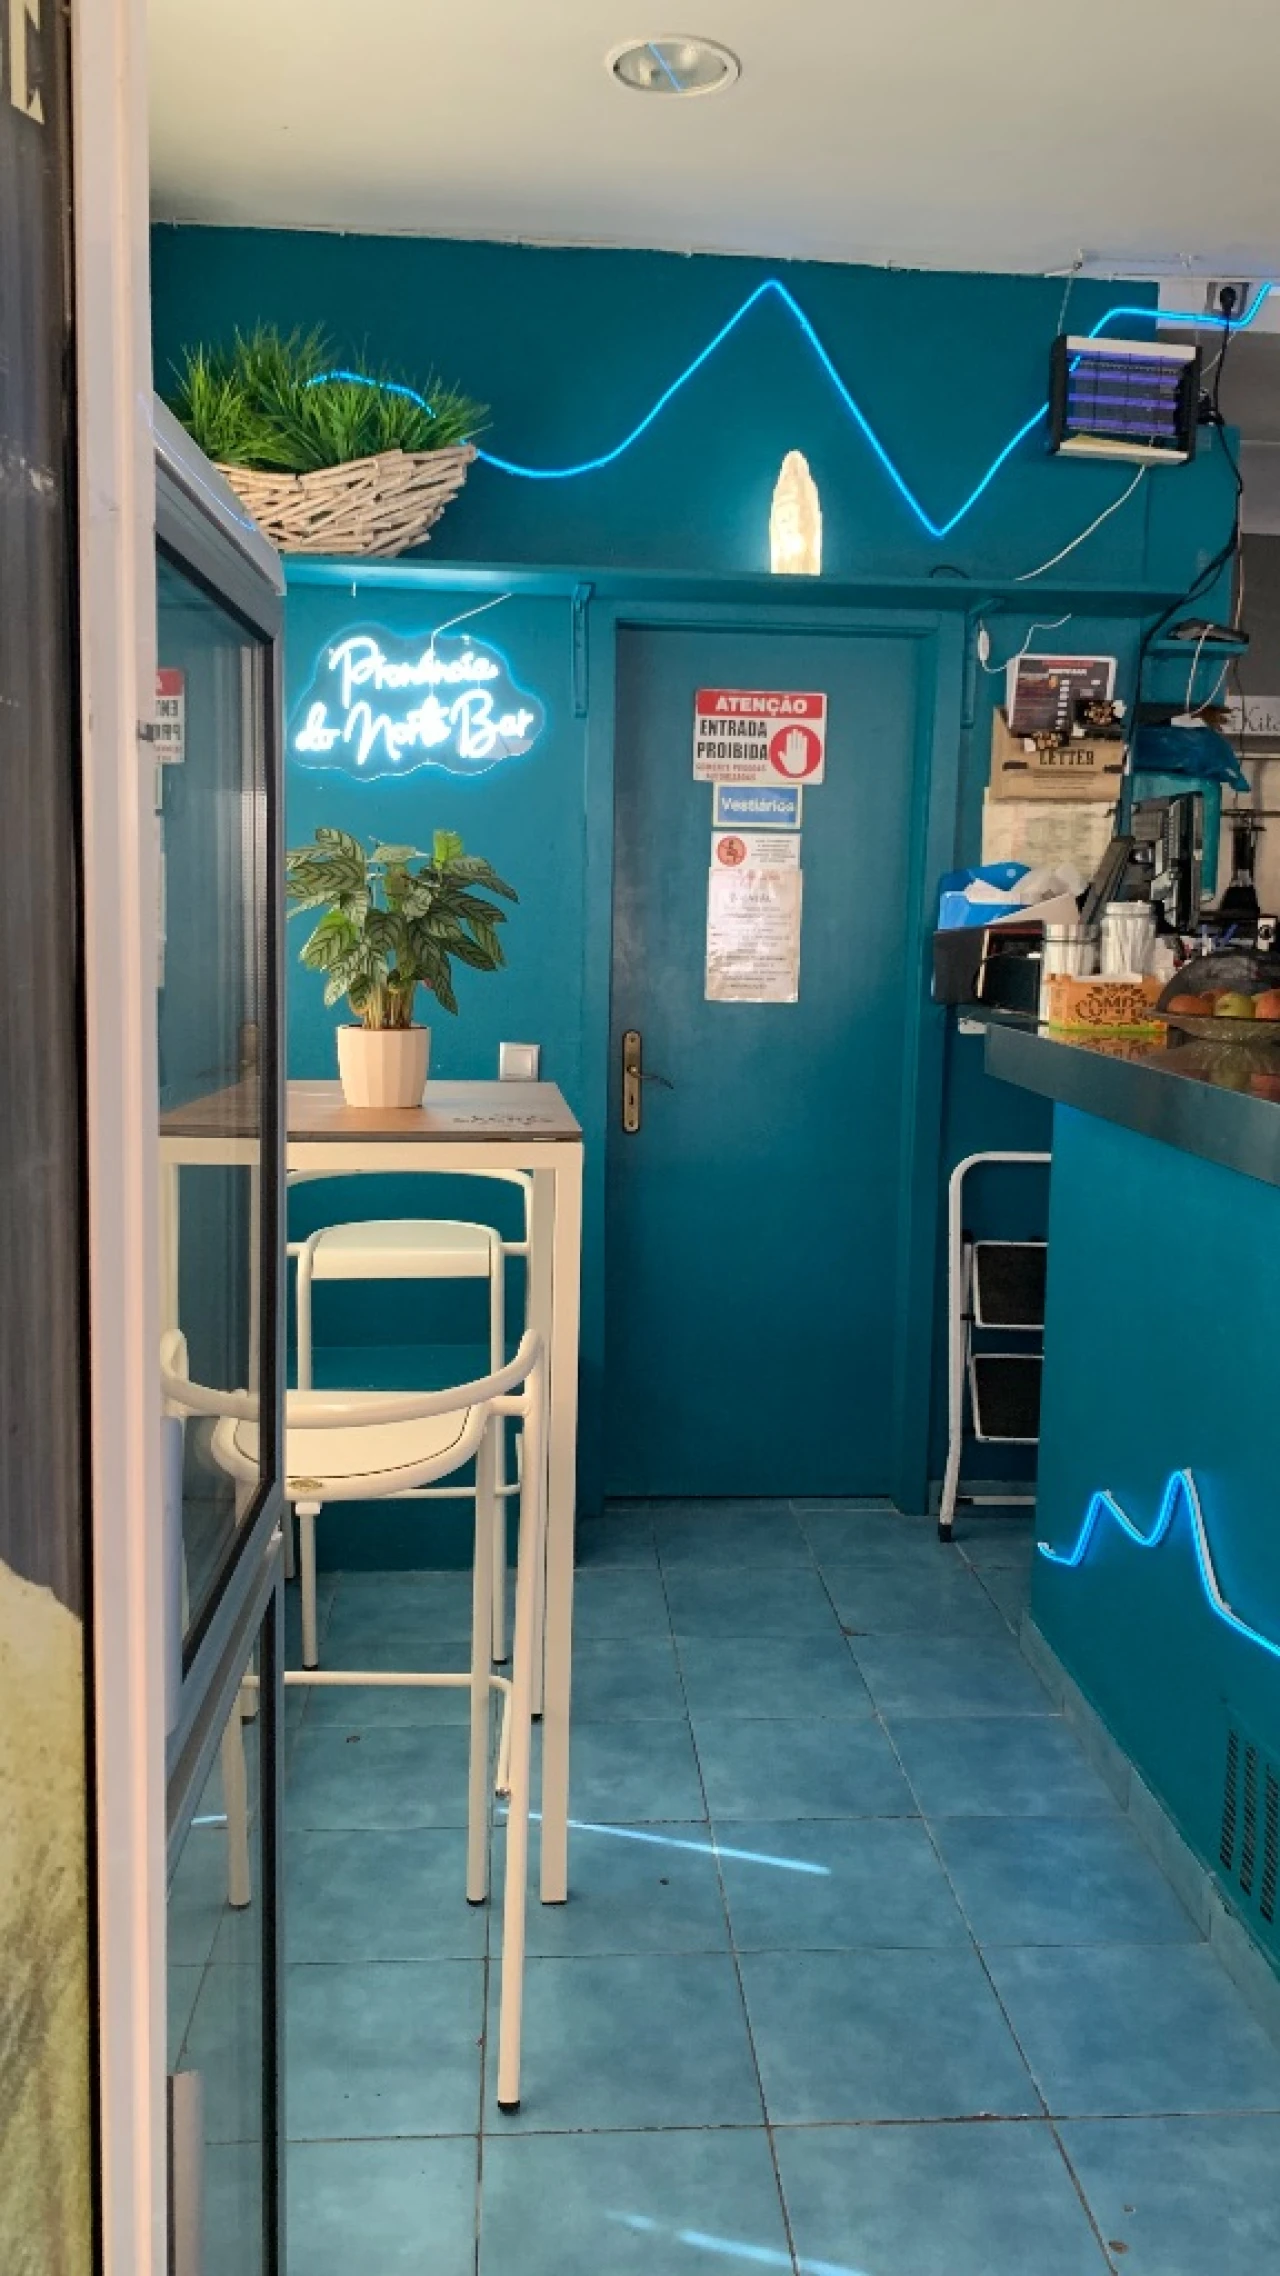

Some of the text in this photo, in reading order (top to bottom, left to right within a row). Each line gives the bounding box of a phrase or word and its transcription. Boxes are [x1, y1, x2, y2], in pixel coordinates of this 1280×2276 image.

[715, 695, 808, 716] ATENÇÃO
[450, 689, 534, 758] Bar
[700, 719, 767, 738] ENTRADA
[697, 742, 768, 760] PROIBIDA
[1039, 750, 1095, 765] LETTER
